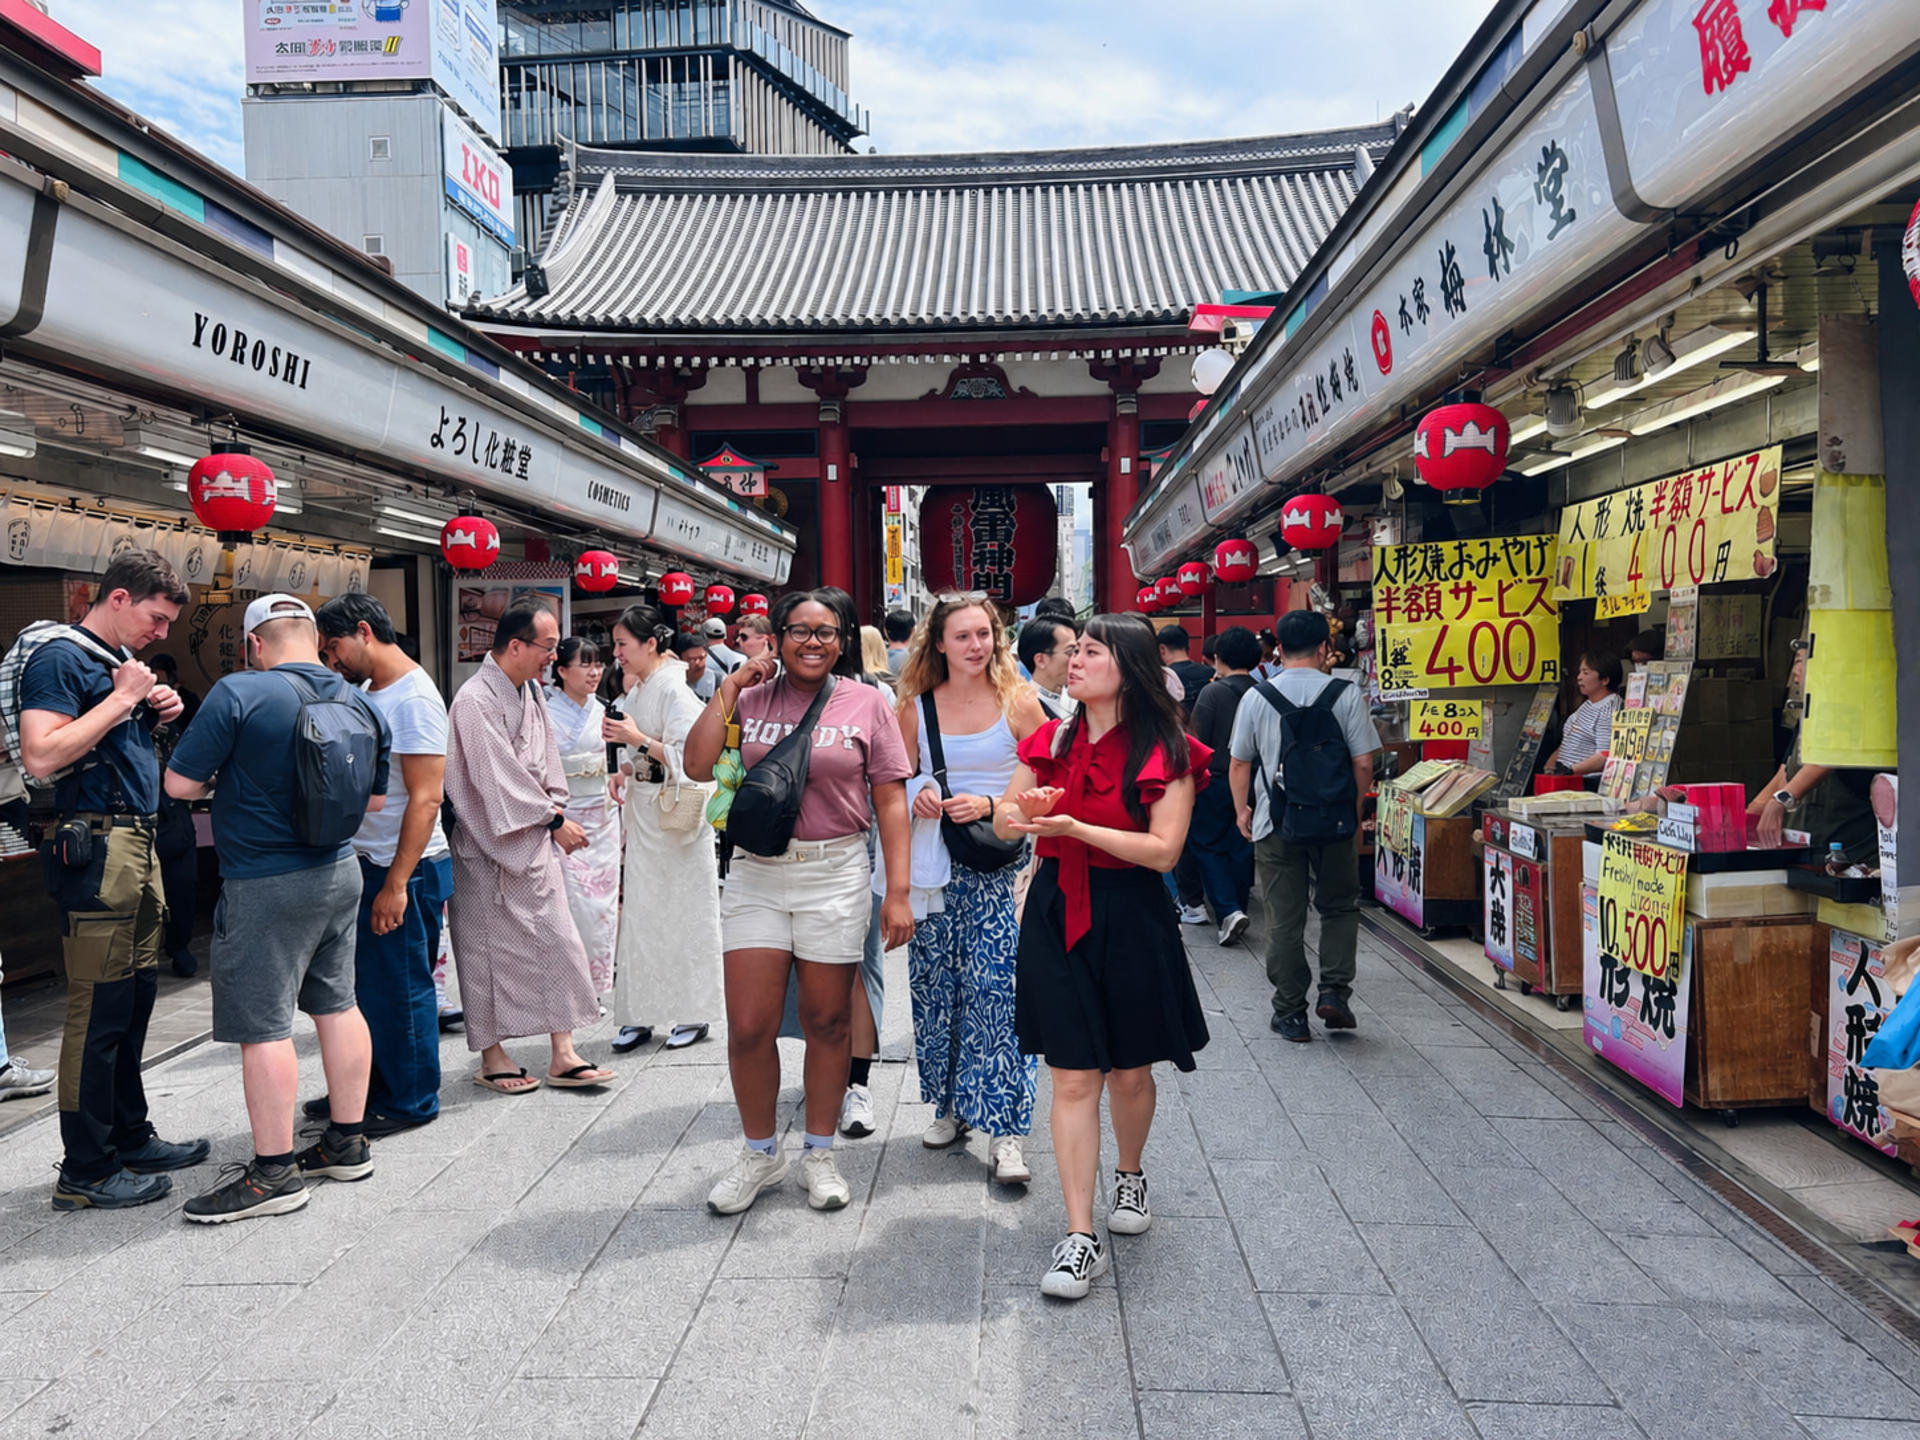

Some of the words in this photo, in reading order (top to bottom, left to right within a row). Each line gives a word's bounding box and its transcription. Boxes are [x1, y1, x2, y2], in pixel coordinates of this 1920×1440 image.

[191, 312, 312, 391] YOROSHI
[430, 404, 533, 482] よろし化粧堂
[587, 480, 632, 513] COSMETICS
[1373, 535, 1556, 586] 人形焼おみやげ
[1376, 576, 1557, 624] 半額サービス
[1418, 720, 1479, 738] 400円
